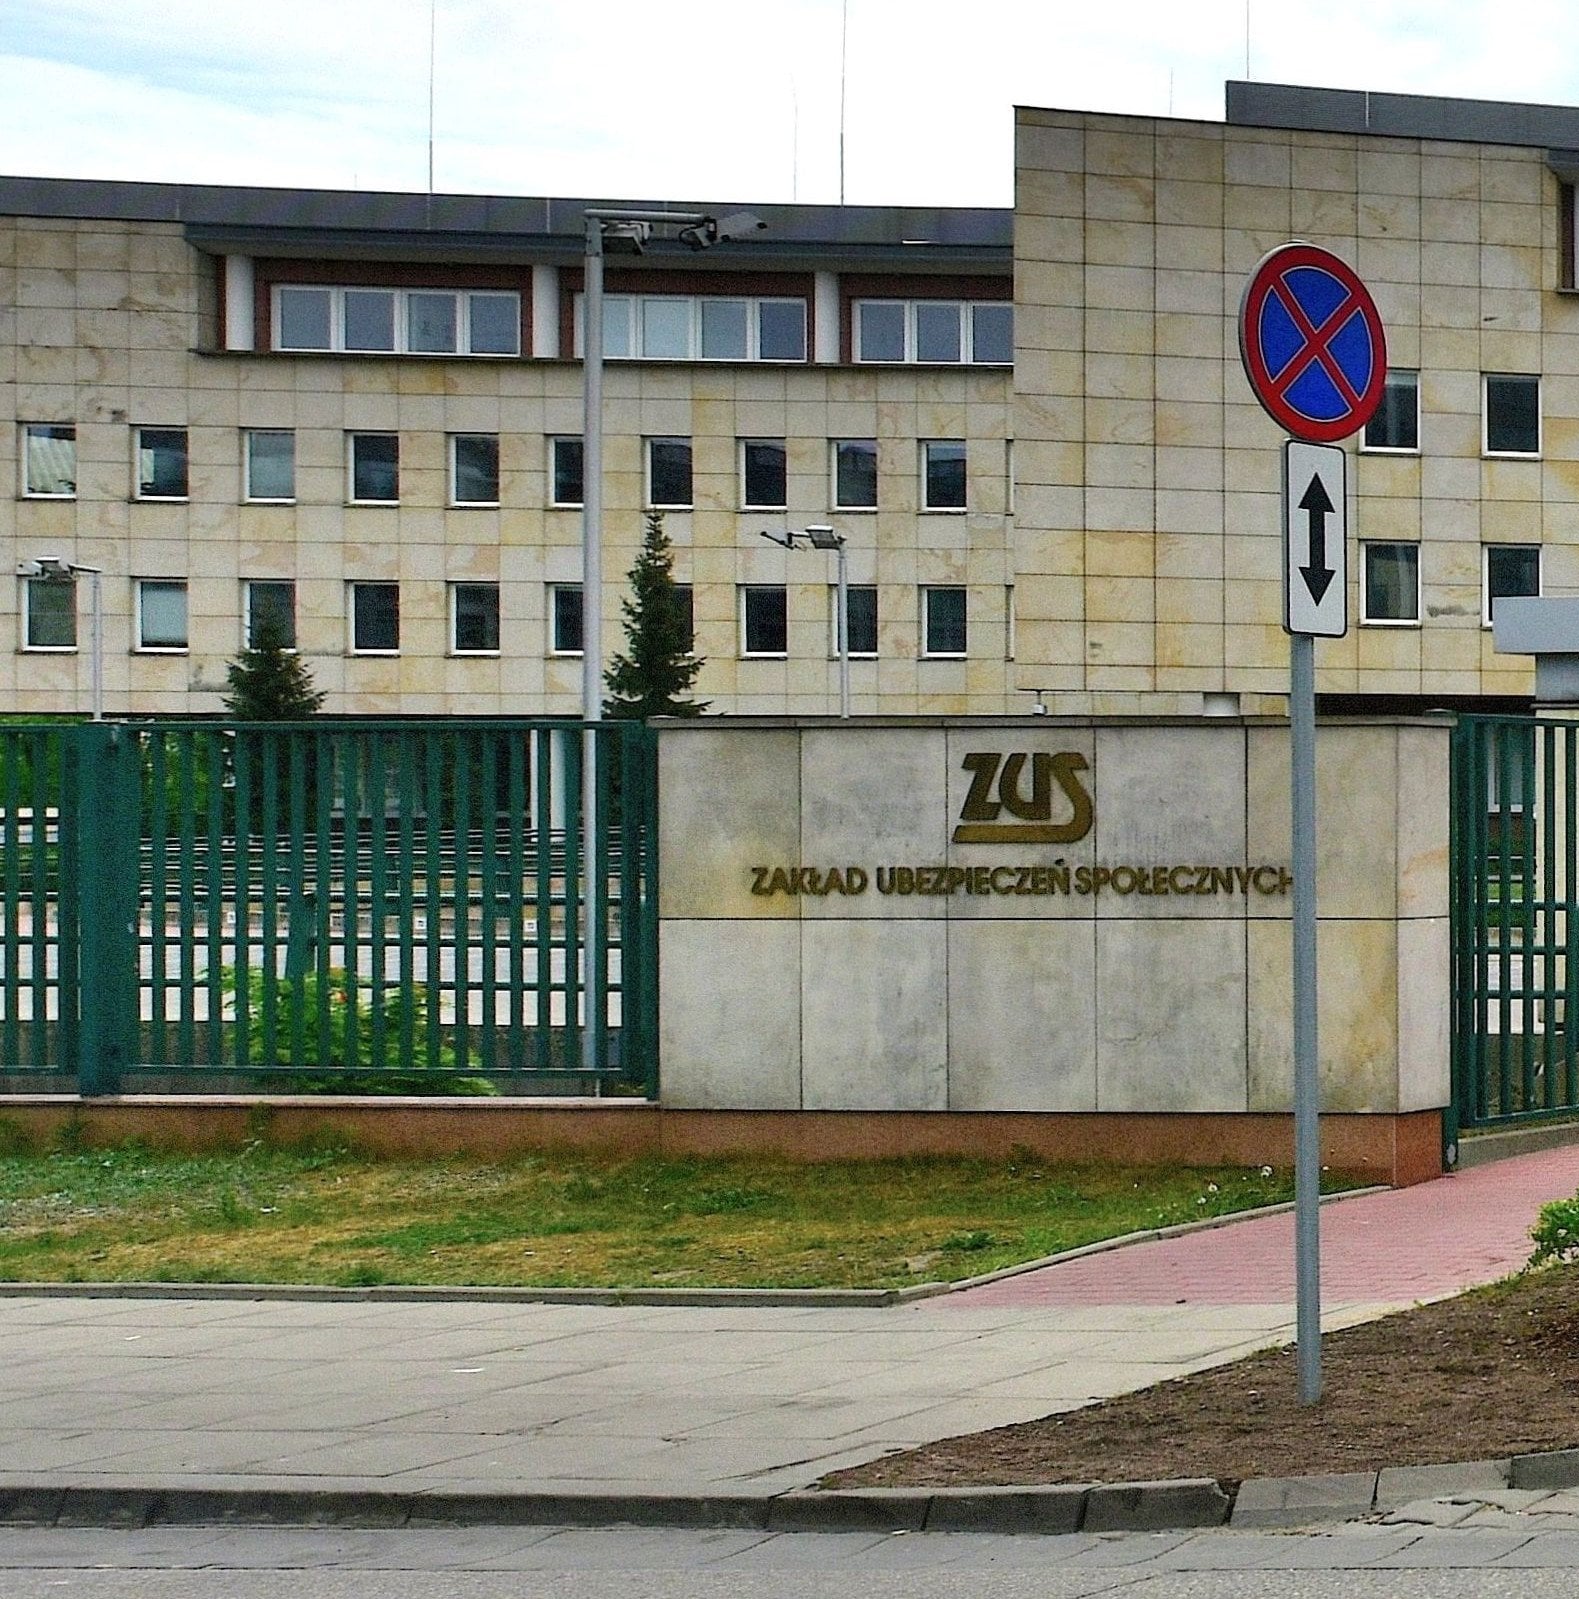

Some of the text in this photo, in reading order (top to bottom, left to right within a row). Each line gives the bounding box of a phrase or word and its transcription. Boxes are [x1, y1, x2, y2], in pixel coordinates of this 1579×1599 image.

[951, 752, 1095, 844] ZUS
[750, 866, 868, 896] ZAKŁAD
[876, 859, 1072, 896] UBEZPIECZEŃ
